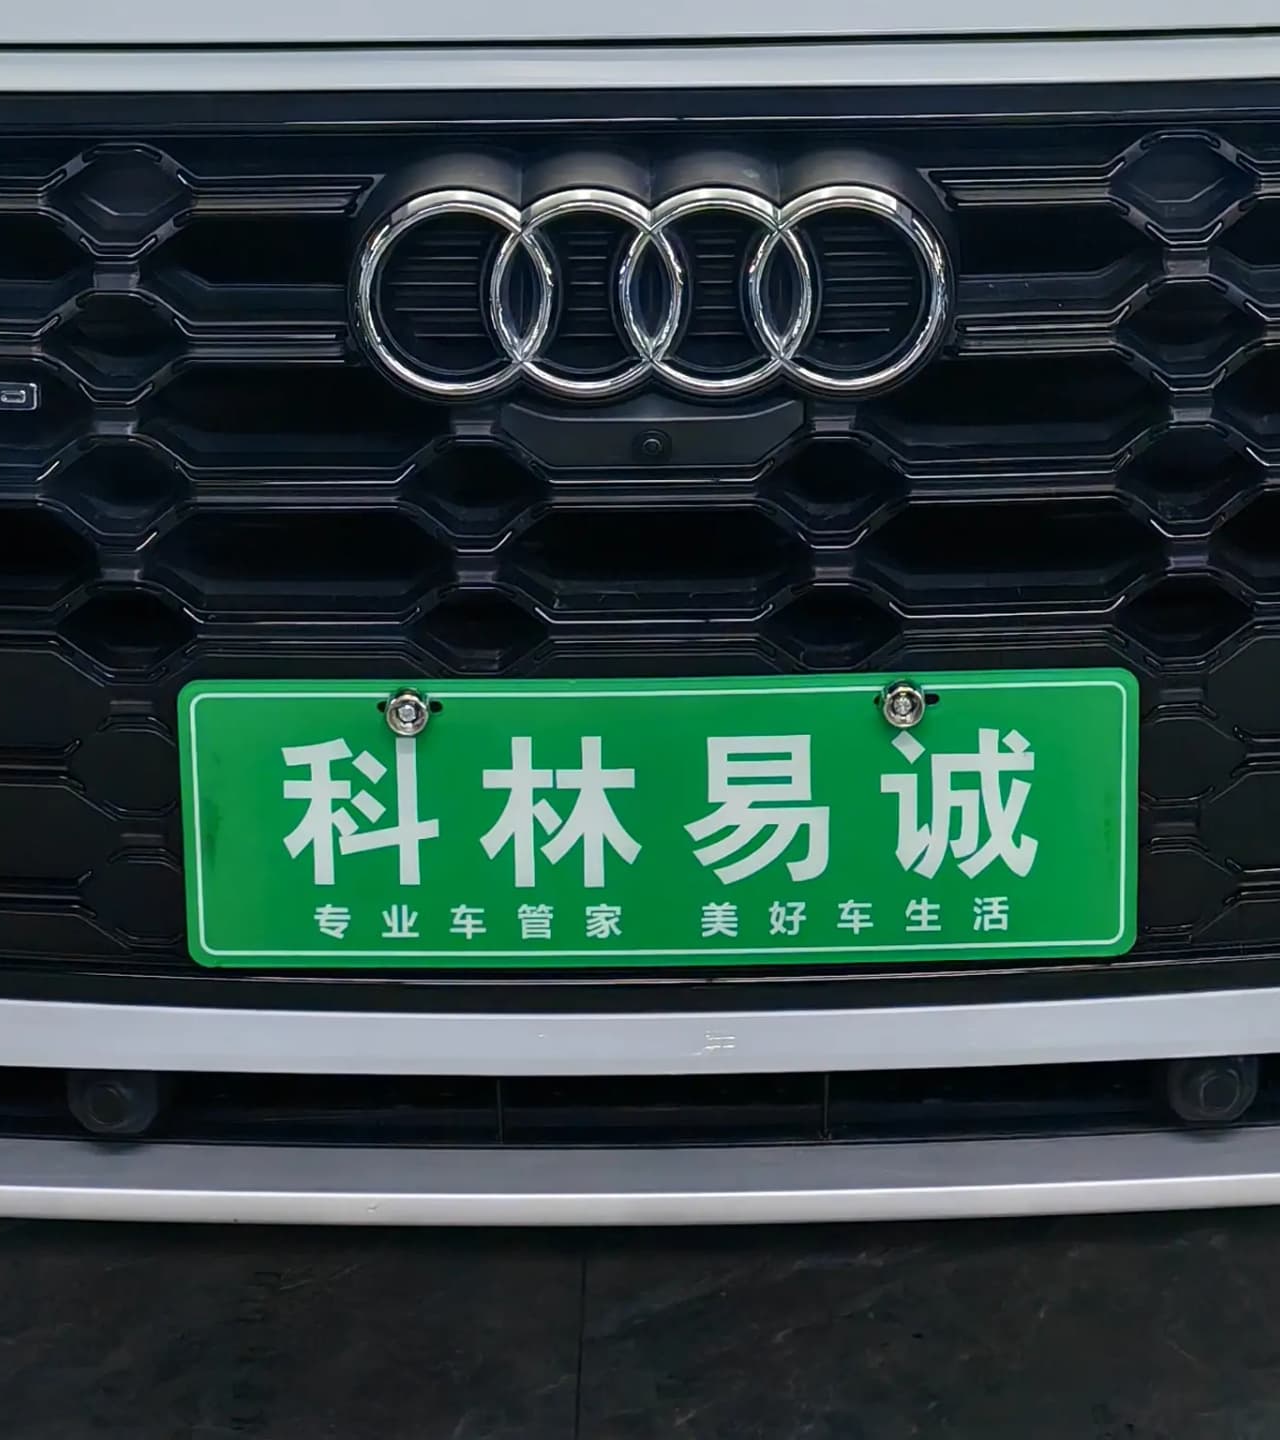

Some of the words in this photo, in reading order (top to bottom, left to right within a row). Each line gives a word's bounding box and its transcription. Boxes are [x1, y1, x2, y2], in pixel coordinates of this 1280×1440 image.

[282, 727, 1039, 888] 科林易诚
[313, 903, 623, 940] 专业车管家
[700, 895, 1010, 938] 美好车生活
